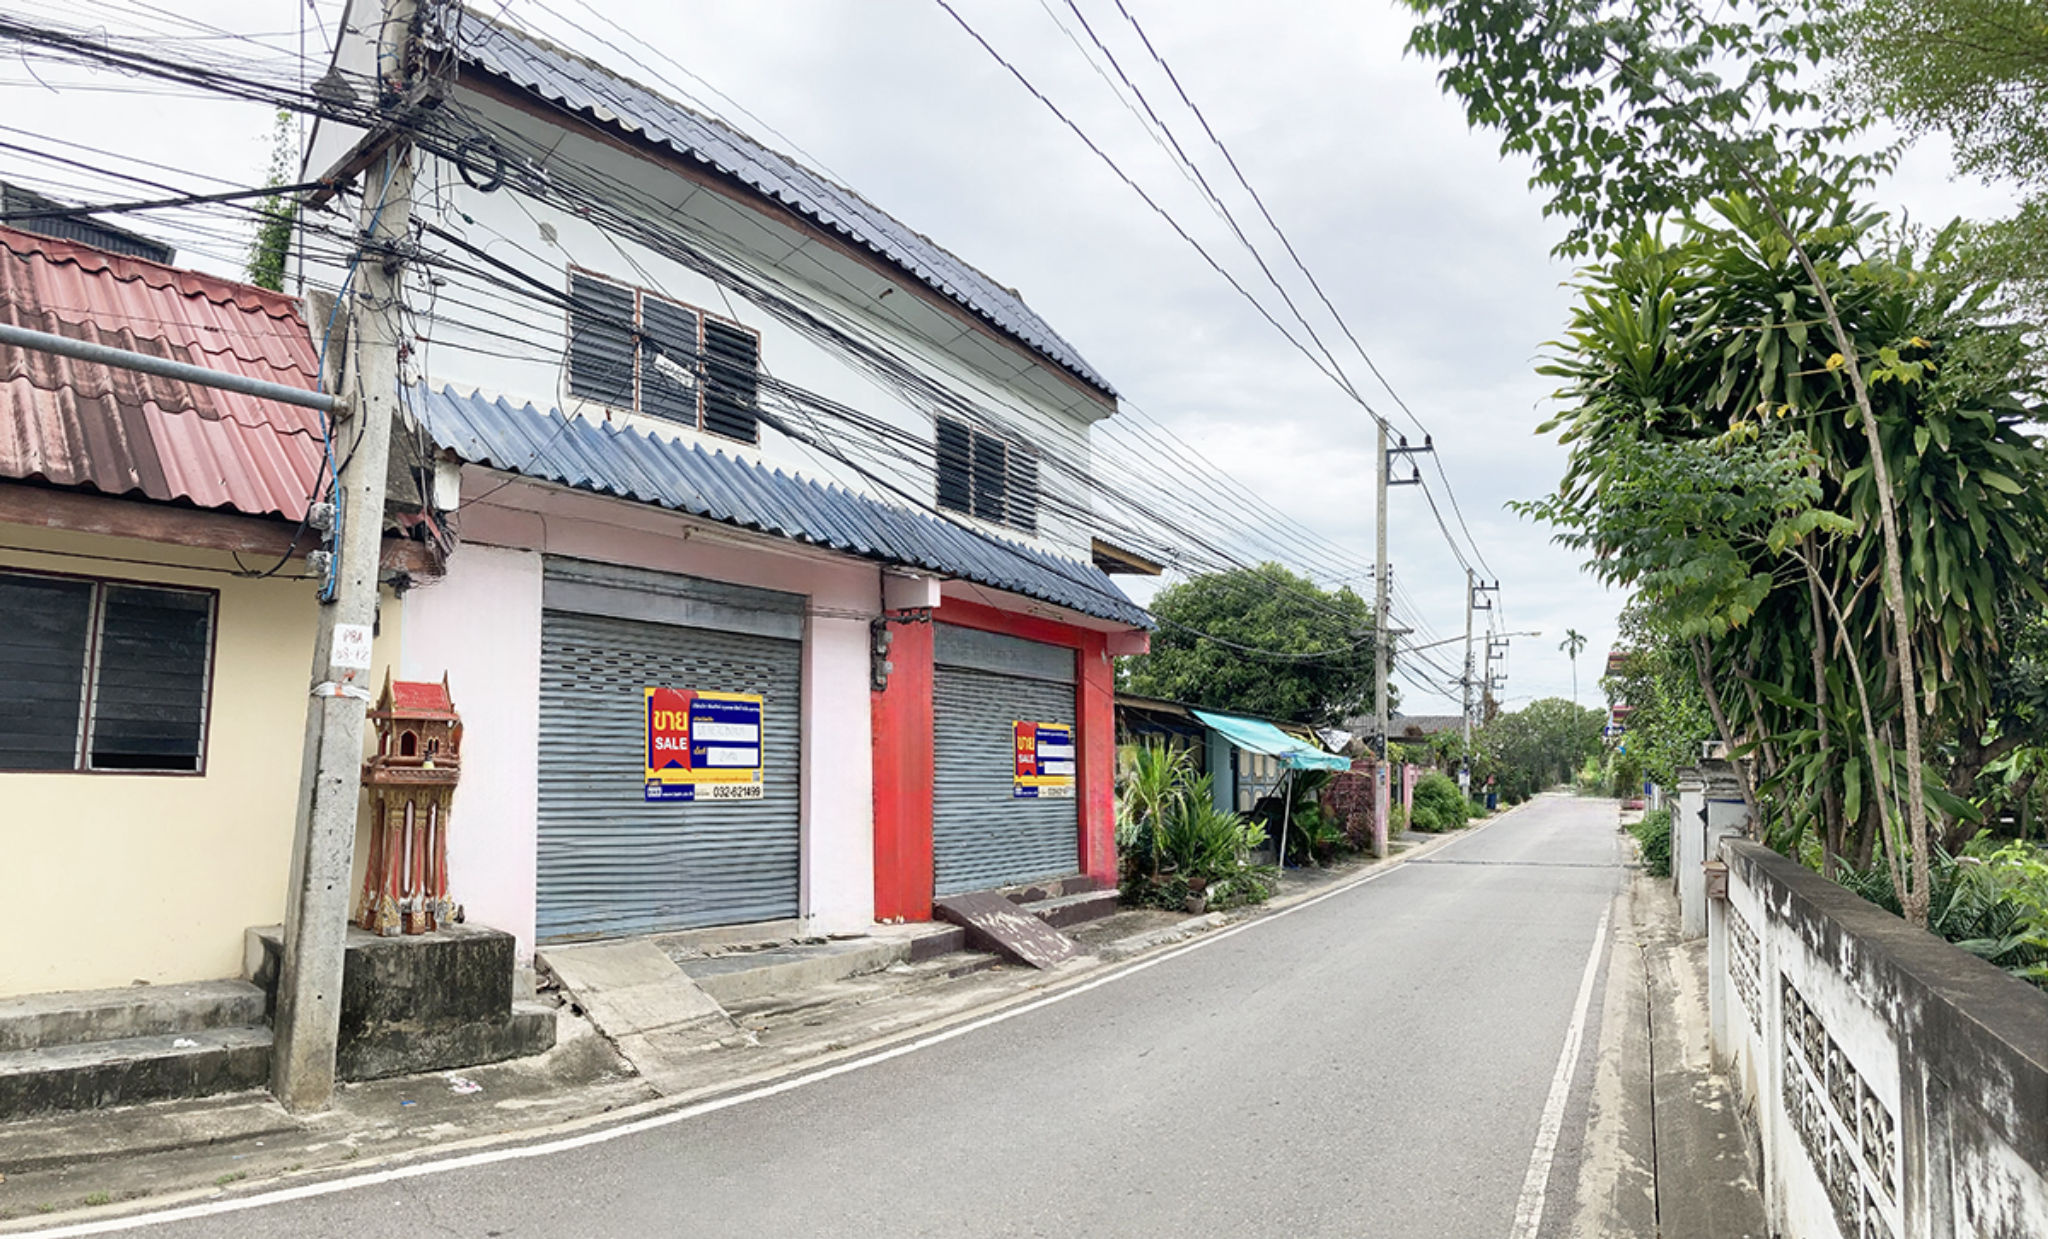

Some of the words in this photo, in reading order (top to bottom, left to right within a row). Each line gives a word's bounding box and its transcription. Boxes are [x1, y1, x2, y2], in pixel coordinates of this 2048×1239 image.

[654, 710, 688, 731] ขาย
[655, 736, 688, 750] SALE
[1018, 754, 1035, 764] SALE
